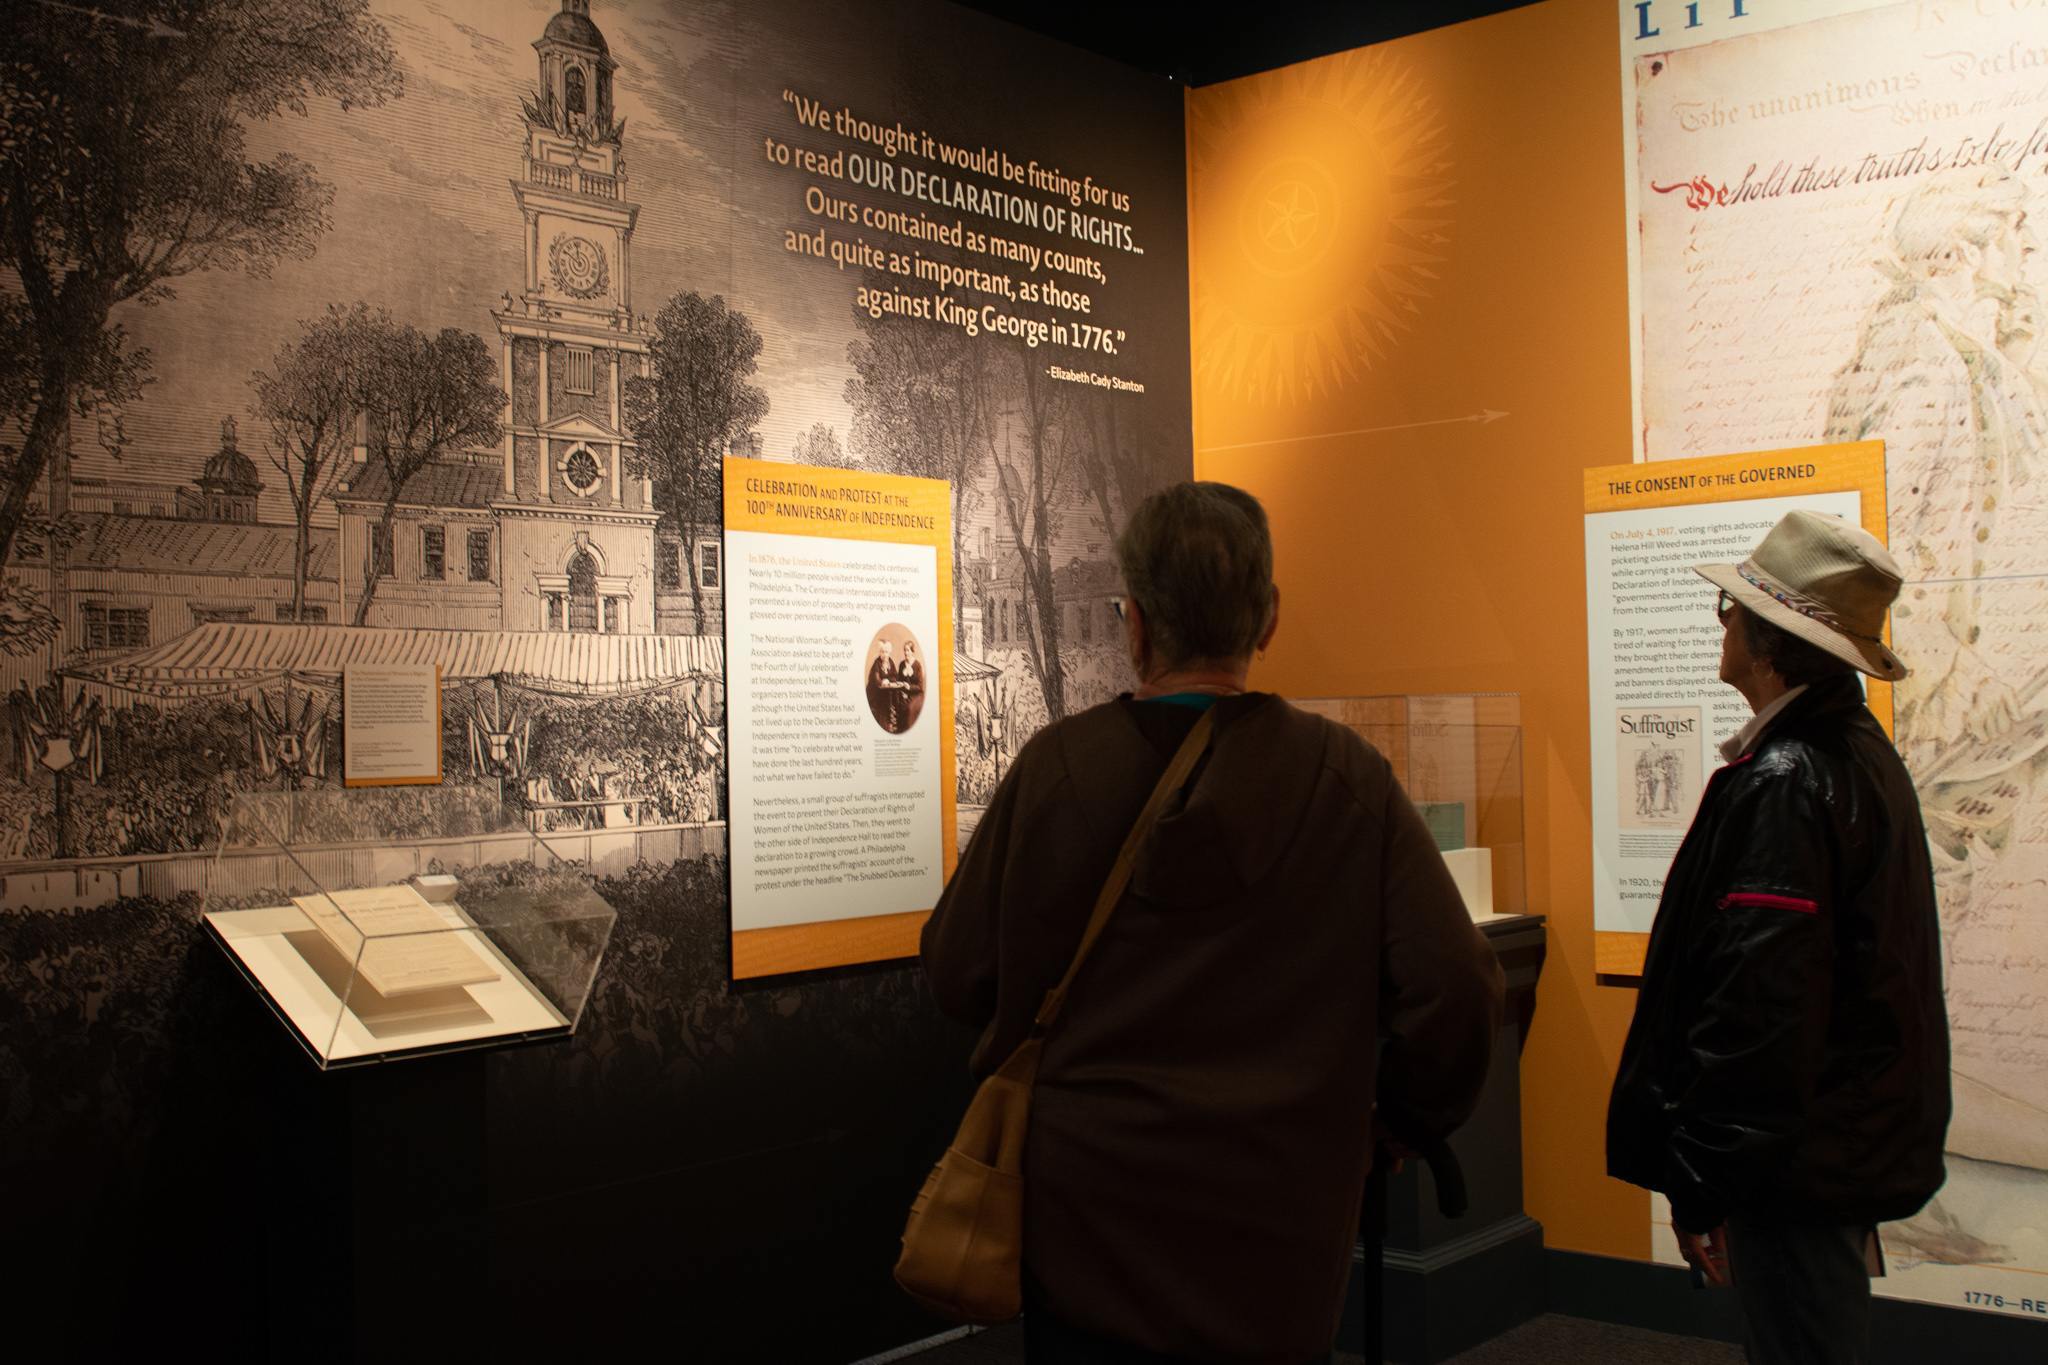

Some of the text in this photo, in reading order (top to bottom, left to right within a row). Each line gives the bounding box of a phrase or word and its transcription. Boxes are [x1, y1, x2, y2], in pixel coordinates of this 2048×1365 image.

[783, 89, 1129, 212] “We thought it would be fitting for us
[1729, 163, 1793, 204] hold
[1790, 156, 1848, 195] these
[1854, 136, 1942, 184] truths
[765, 137, 789, 165] to
[795, 148, 843, 179] read
[848, 153, 895, 192] OUR
[902, 166, 1037, 228] DECLARATION
[1043, 204, 1065, 234] OF
[806, 186, 1106, 285] Ours contained as many counts,
[785, 228, 1090, 313] and quite as important, as those
[857, 286, 1125, 355] against King George in 1776.”
[1090, 372, 1110, 390] Cady
[1112, 377, 1143, 392] Stanton
[1608, 464, 1814, 495] THE CONSENT OF THE GOVERNED
[746, 477, 908, 507] CELEBRATION AND PROTEST AT THE
[775, 502, 846, 521] ANNIVERSARY
[849, 512, 859, 523] OF
[861, 511, 934, 529] INDEPENDENCE
[1678, 526, 1705, 534] voting
[1707, 523, 1731, 533] rights
[1733, 520, 1773, 530] advocate
[1611, 543, 1639, 552] Helena
[1641, 541, 1654, 550] Hill
[1656, 539, 1680, 549] Weed
[1700, 535, 1736, 546] arrested
[1738, 535, 1751, 543] for
[1611, 555, 1649, 566] picketing
[1650, 552, 1681, 562] outside
[1682, 551, 1697, 560] the
[1698, 550, 1725, 558] White
[1611, 568, 1634, 577] while
[1636, 567, 1668, 576] carrying
[1612, 580, 1659, 590] Declaration
[1661, 578, 1669, 587] of
[1671, 591, 1700, 599] derive
[1612, 606, 1634, 615] from
[1650, 604, 1682, 613] consent
[1684, 603, 1694, 611] of
[1695, 602, 1709, 610] the
[1614, 629, 1624, 638] By
[1614, 641, 1633, 649] tired
[1646, 640, 1676, 649] waiting
[1677, 639, 1690, 647] for
[1692, 638, 1706, 646] the
[1614, 654, 1632, 662] they
[1633, 653, 1666, 662] brought
[1669, 652, 1687, 660] their
[1614, 665, 1662, 675] amendment
[1631, 679, 1664, 687] banners
[1665, 677, 1705, 686] displayed
[1615, 691, 1652, 700] appealed
[1653, 690, 1685, 699] directly
[1698, 688, 1738, 697] President
[1712, 702, 1740, 711] asking
[1620, 713, 1695, 739] Suffragist
